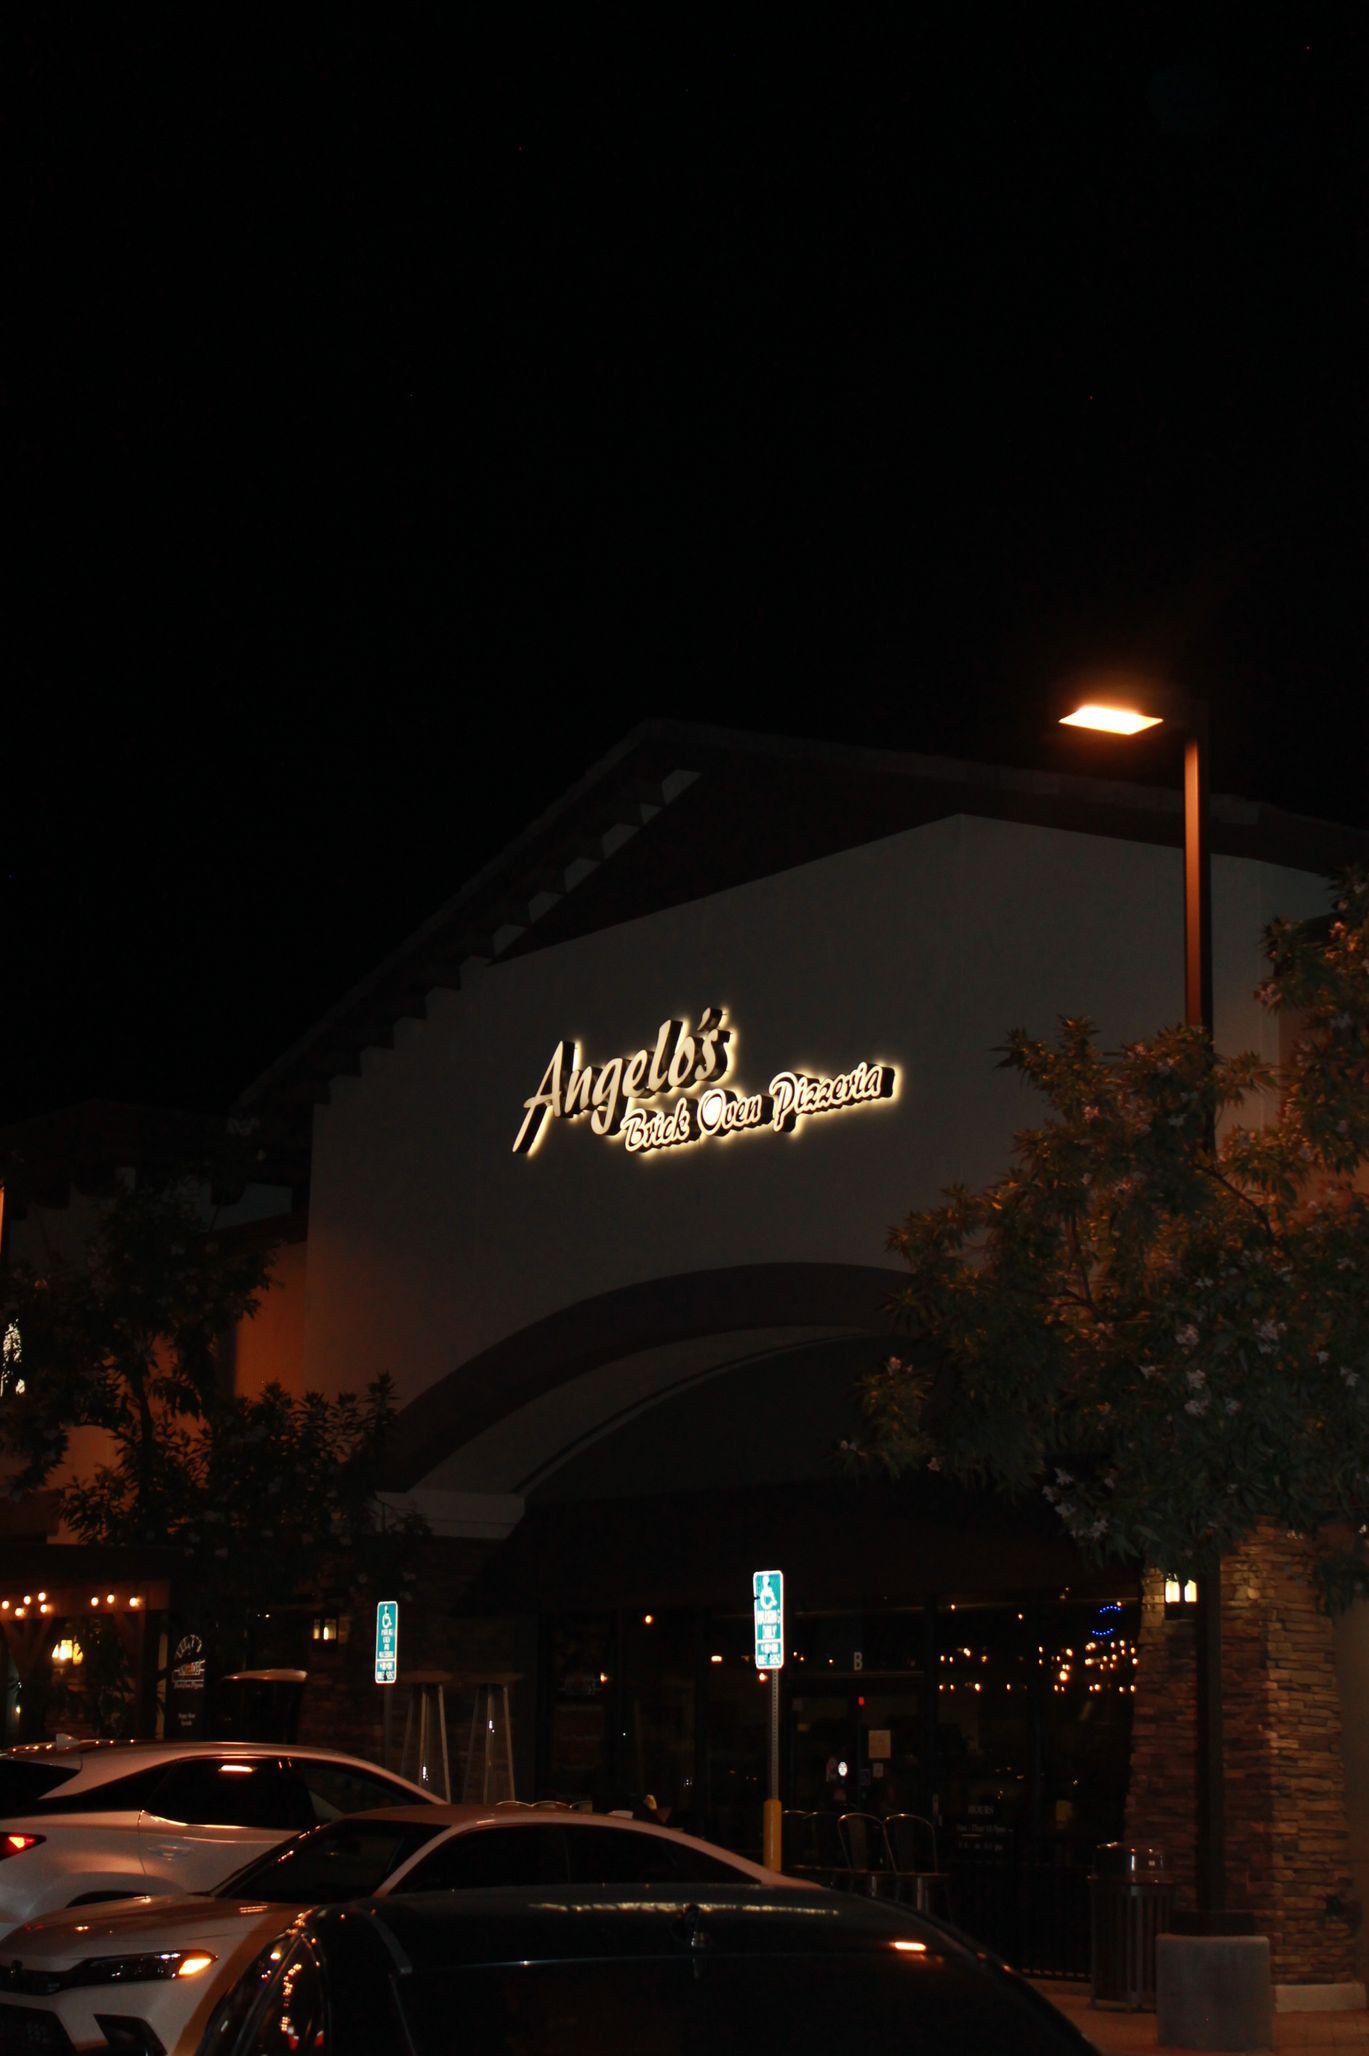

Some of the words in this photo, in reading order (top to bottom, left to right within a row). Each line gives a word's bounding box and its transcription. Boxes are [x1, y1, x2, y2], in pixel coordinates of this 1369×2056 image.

[512, 1007, 730, 1154] Angelo's
[621, 1101, 692, 1152] Brick
[696, 1088, 764, 1136] Oven
[769, 1061, 886, 1132] Pizzeria
[853, 1651, 863, 1671] B
